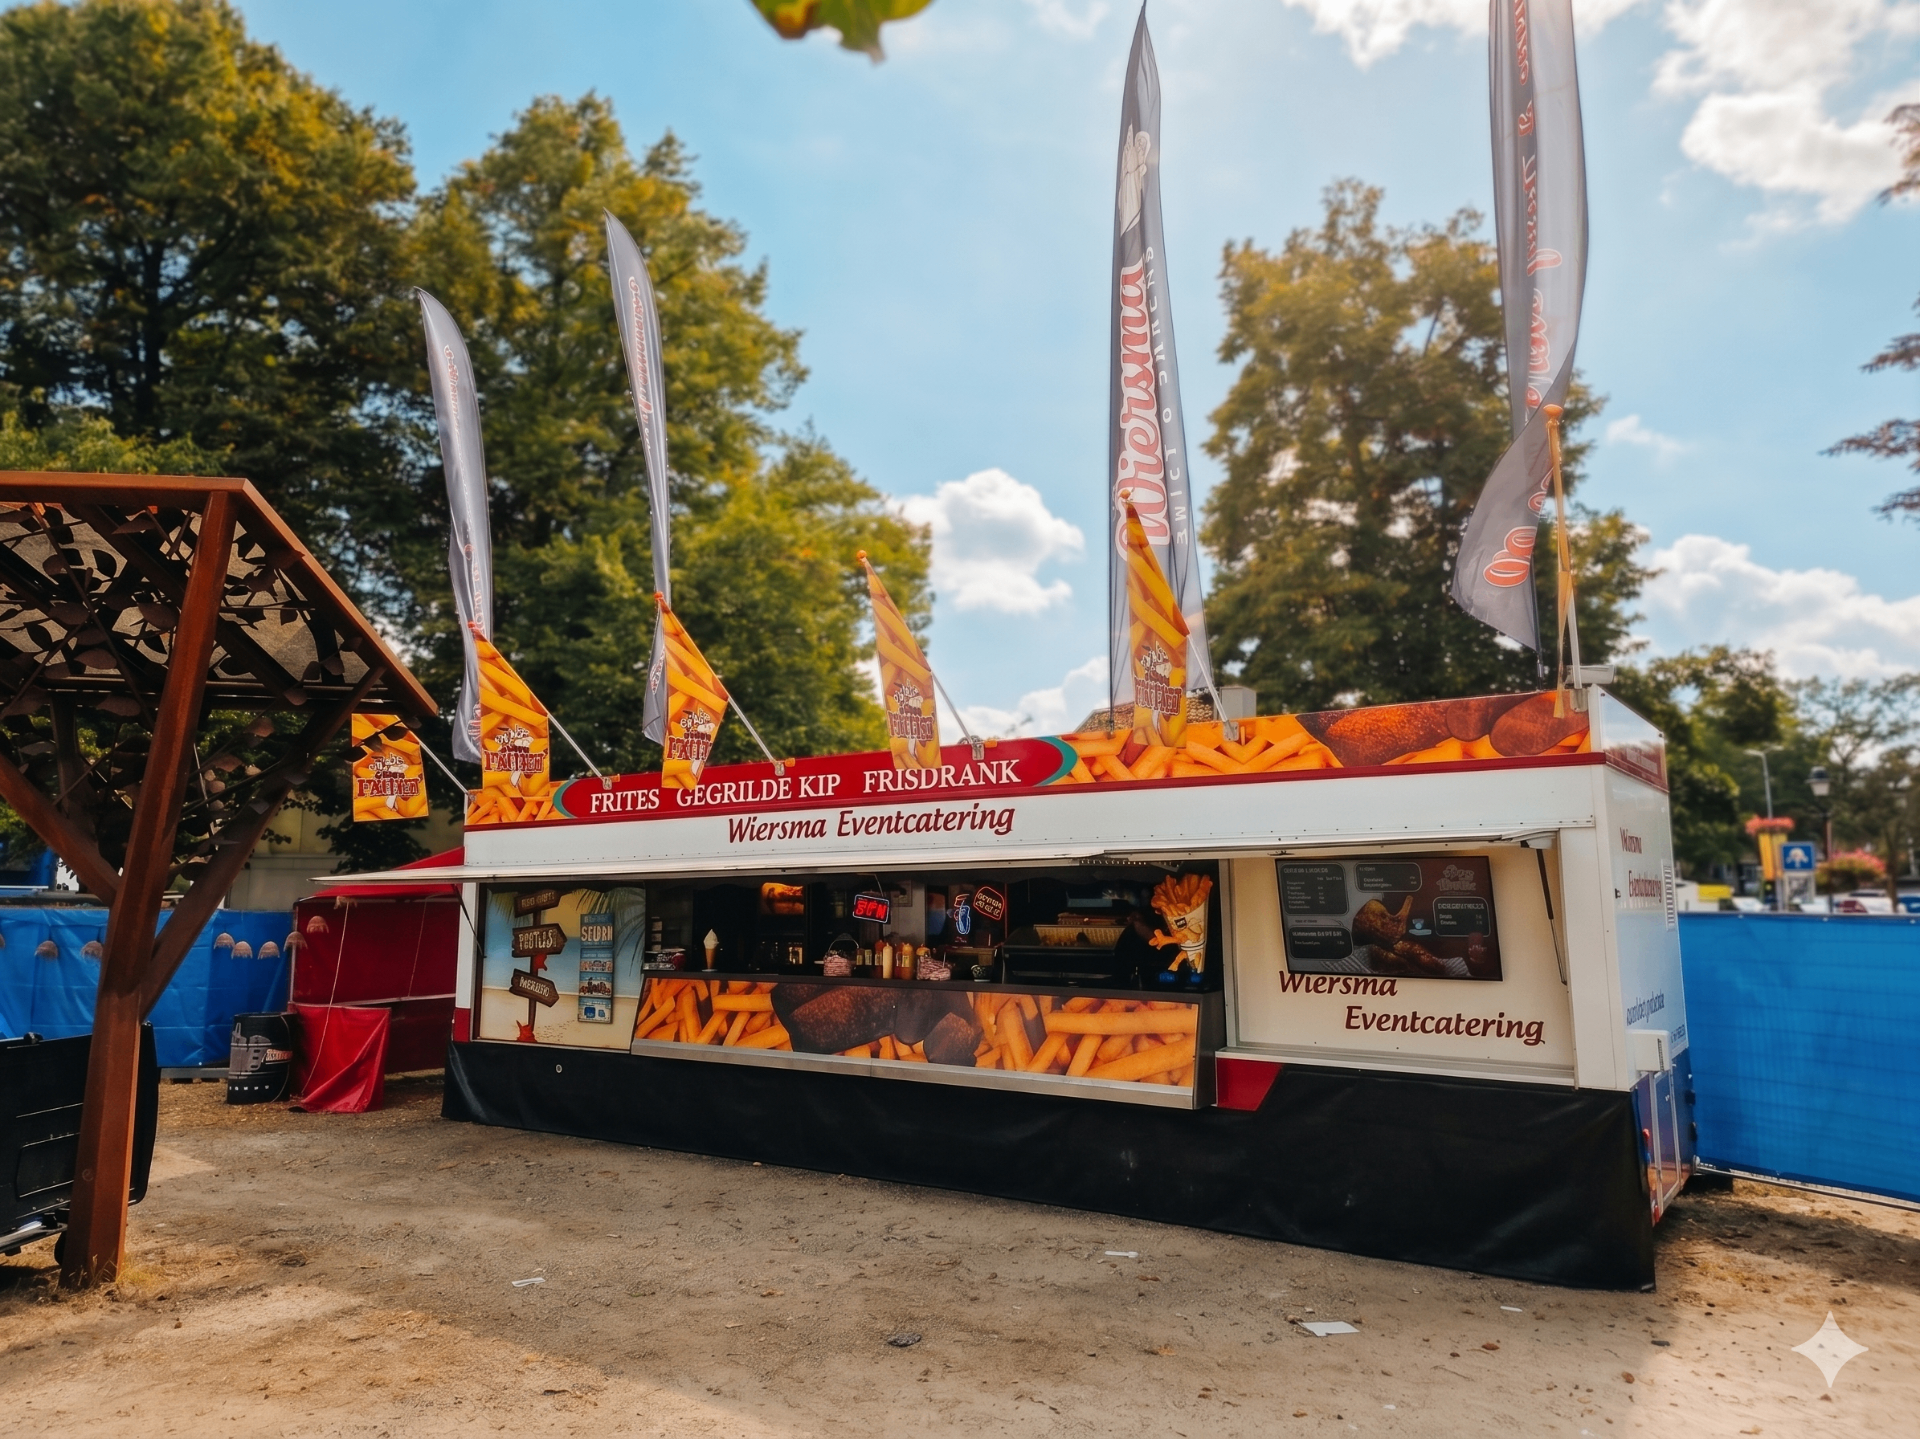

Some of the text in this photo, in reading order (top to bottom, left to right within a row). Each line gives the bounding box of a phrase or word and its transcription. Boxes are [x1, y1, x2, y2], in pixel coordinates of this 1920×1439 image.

[1115, 260, 1170, 559] Wiersma
[590, 759, 1021, 814] FRITES GEGRILDE KIP FRISDRANK
[728, 802, 1016, 844] Wiersma Eventcatering
[1279, 970, 1398, 997] Wiersma
[1344, 1005, 1546, 1046] Eventcatering
